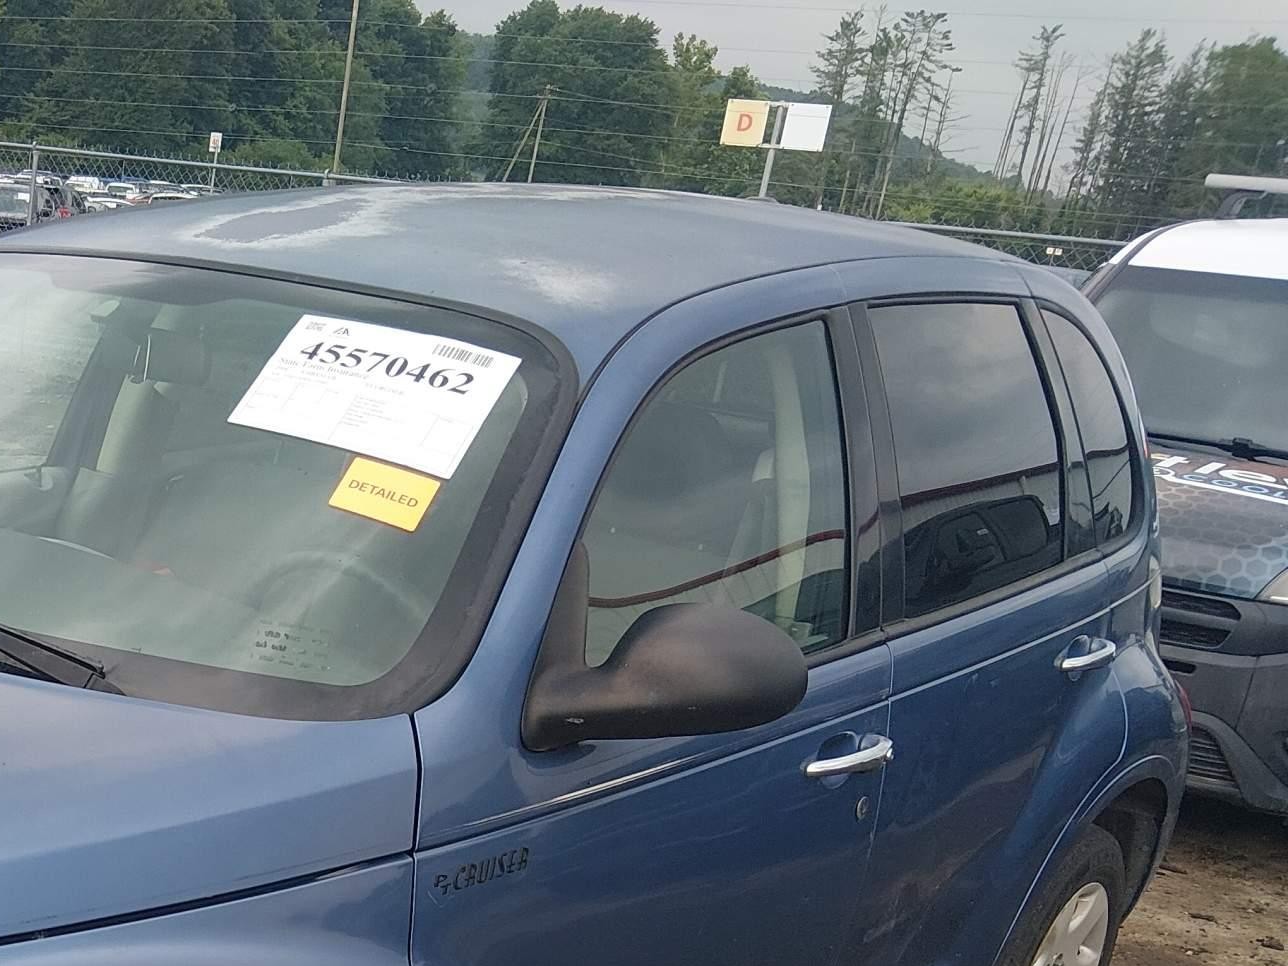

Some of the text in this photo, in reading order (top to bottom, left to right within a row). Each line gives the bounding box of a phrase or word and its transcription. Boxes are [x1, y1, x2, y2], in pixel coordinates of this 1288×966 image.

[736, 113, 753, 132] D
[300, 341, 474, 395] 45570462
[348, 479, 419, 508] DETAILED
[453, 847, 530, 891] CRUISER
